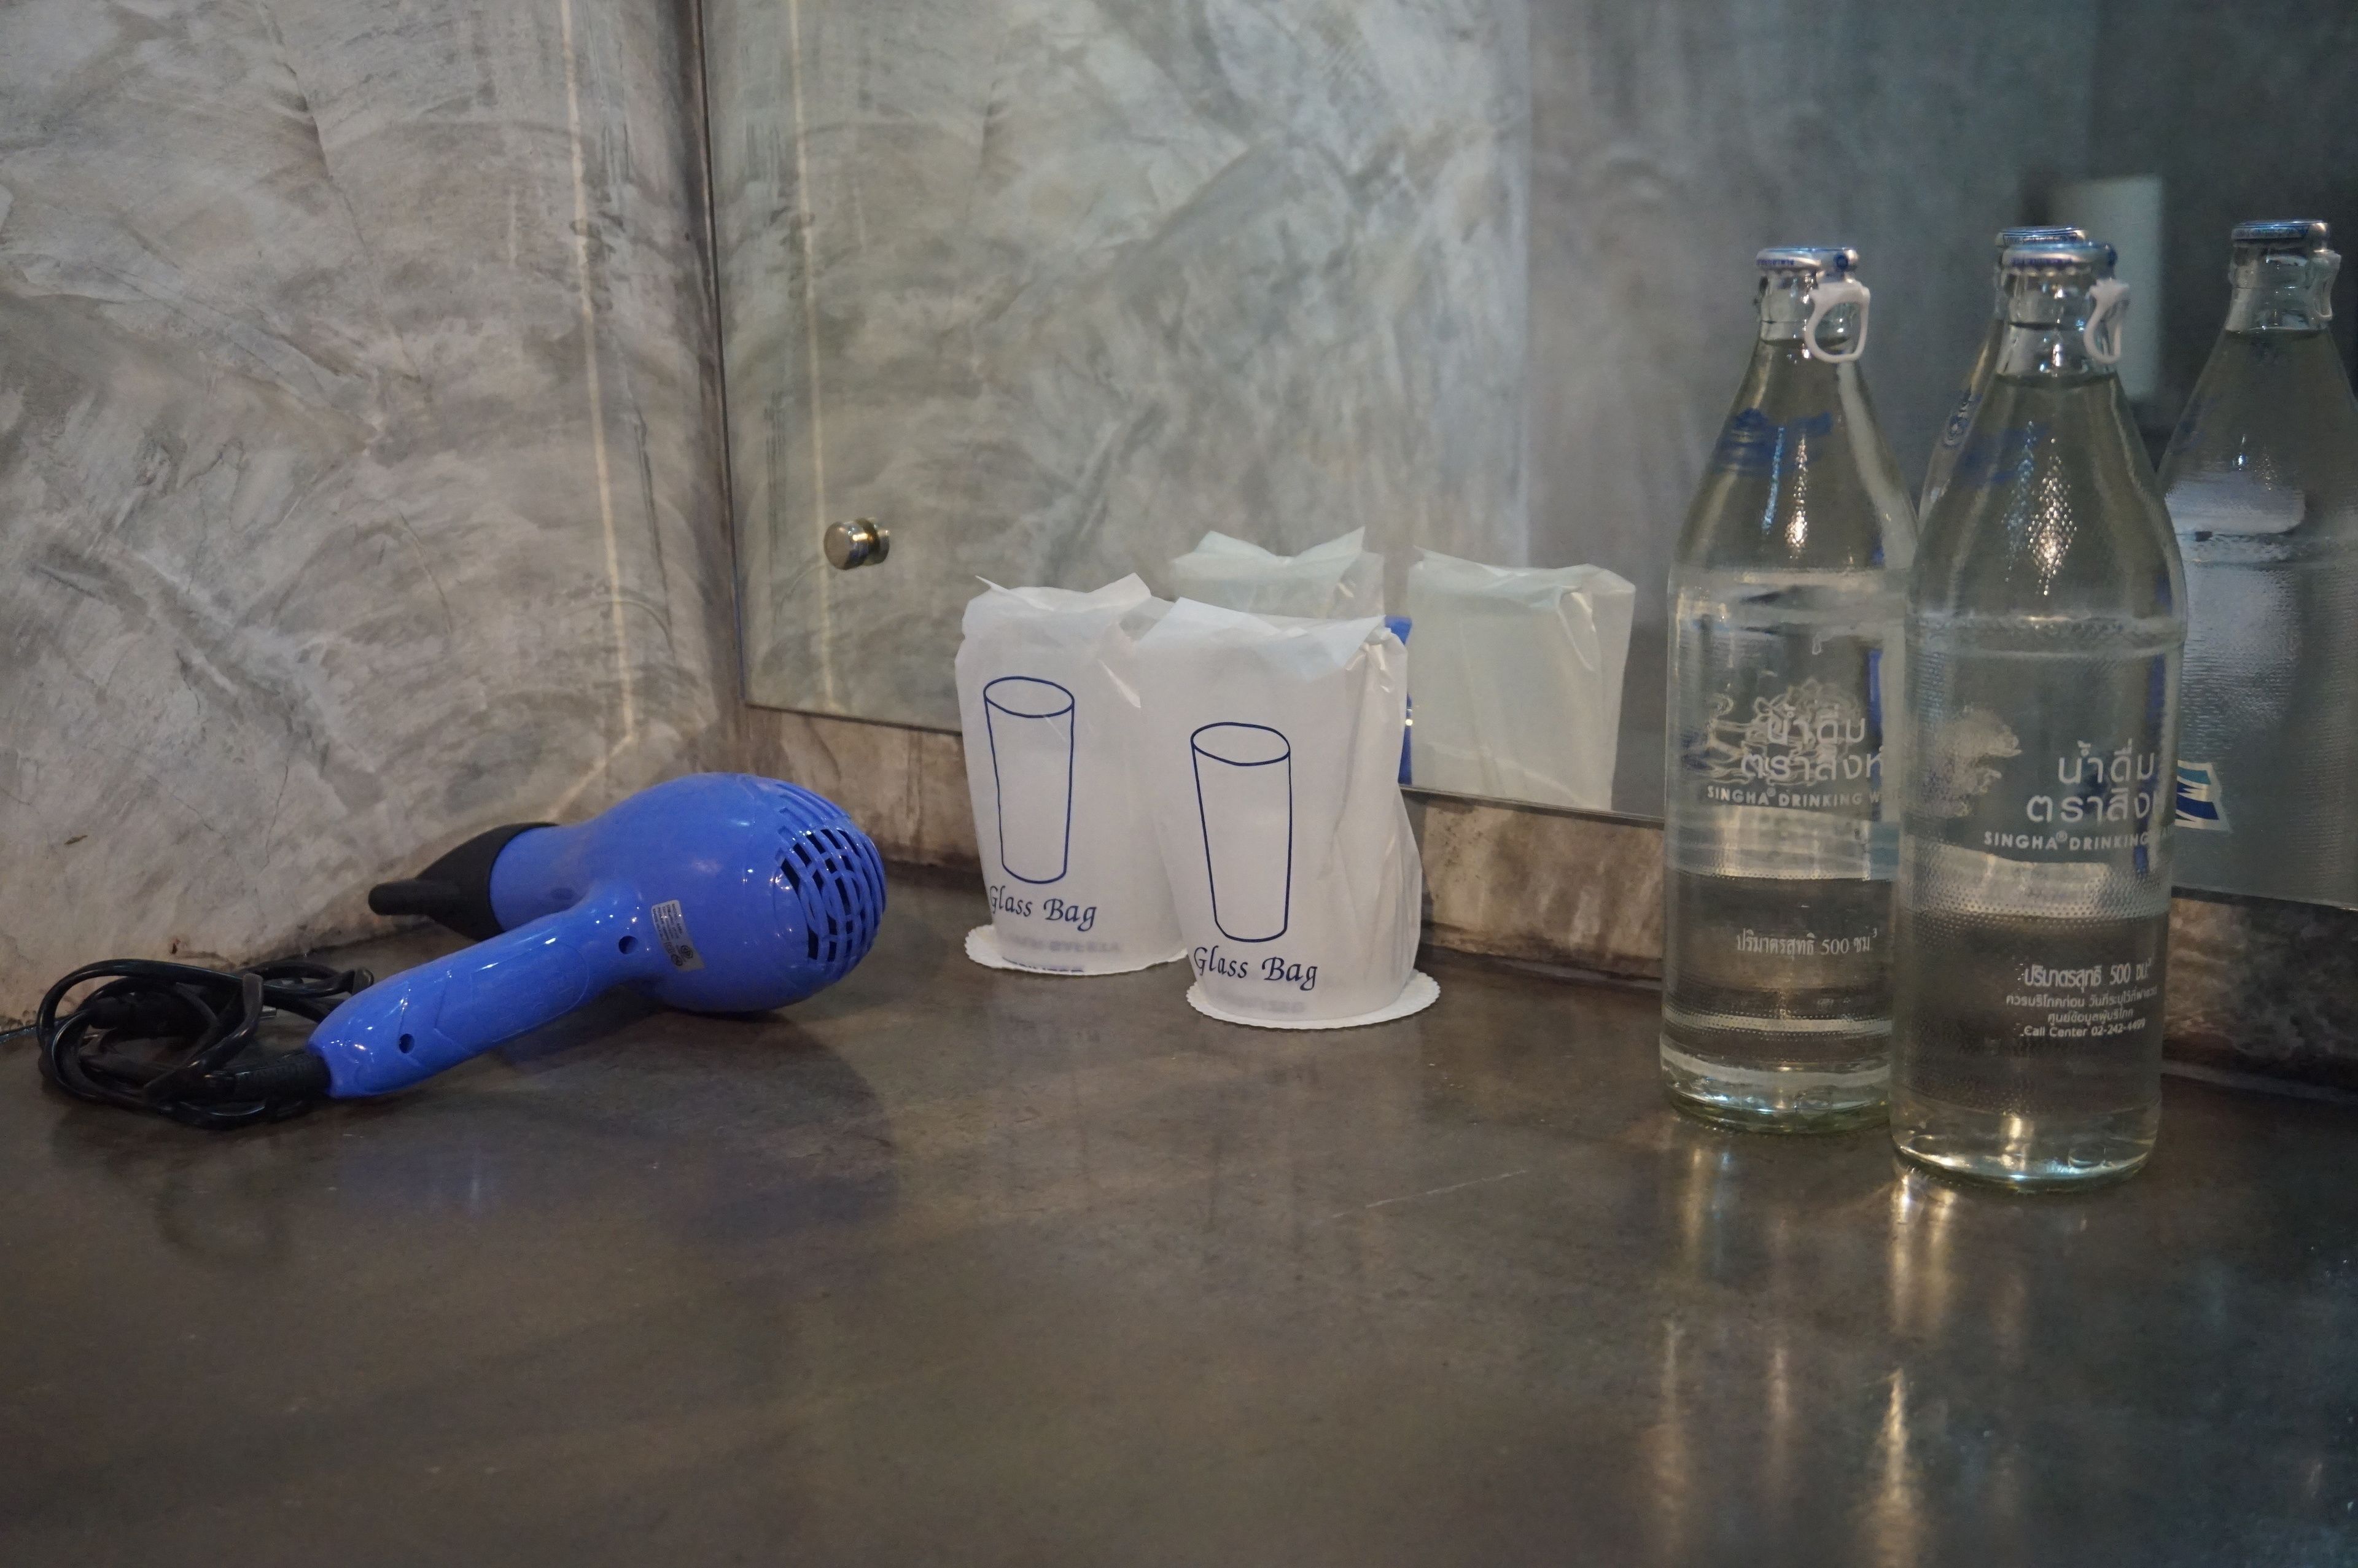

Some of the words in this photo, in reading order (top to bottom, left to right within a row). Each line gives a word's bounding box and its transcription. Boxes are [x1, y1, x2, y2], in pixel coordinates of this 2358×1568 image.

[2058, 738, 2155, 784] น้ำดื่ม
[1778, 793, 1862, 807] DRINKING
[2069, 831, 2149, 851] DRINKING
[989, 886, 1032, 917] Glass
[1043, 898, 1097, 931] Bag
[1821, 938, 1850, 955] 500
[1193, 946, 1248, 979] Glass
[1262, 957, 1318, 991] Bag
[2109, 962, 2131, 985] 500
[2024, 1025, 2045, 1036] Call
[2049, 1026, 2087, 1037] Center
